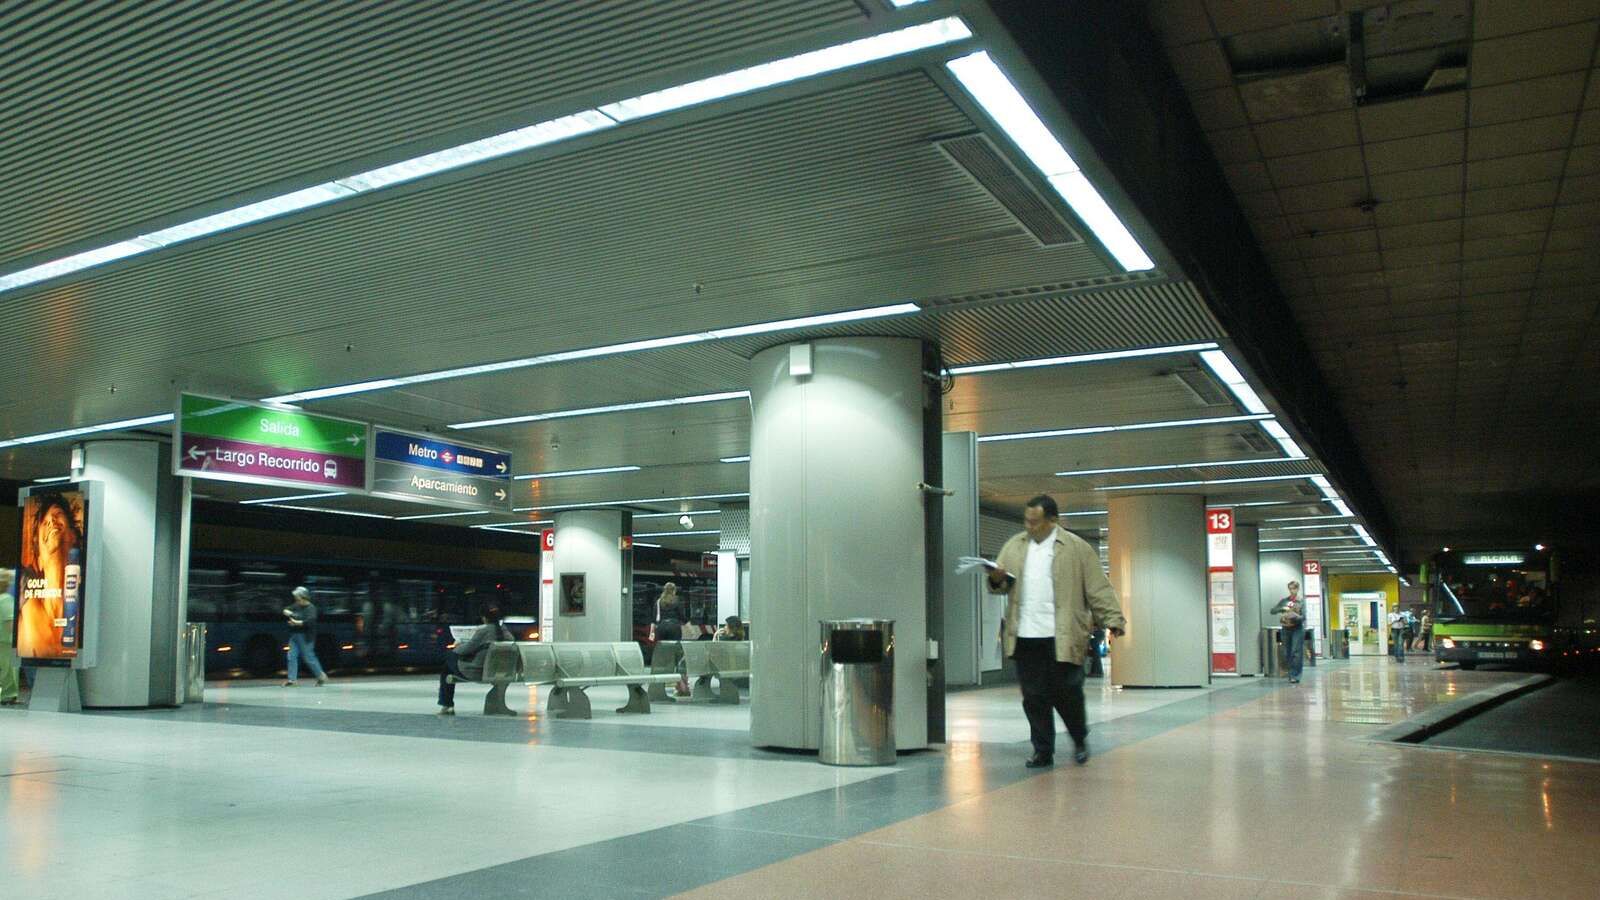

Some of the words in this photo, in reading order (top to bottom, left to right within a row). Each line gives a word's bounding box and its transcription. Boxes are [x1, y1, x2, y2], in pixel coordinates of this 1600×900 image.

[259, 418, 300, 437] Salida
[215, 447, 255, 467] Largo
[258, 452, 320, 473] Recorrido
[408, 443, 438, 460] Metro
[410, 475, 478, 496] Aparcamiento
[1209, 513, 1230, 529] 13
[1305, 562, 1318, 573] 12
